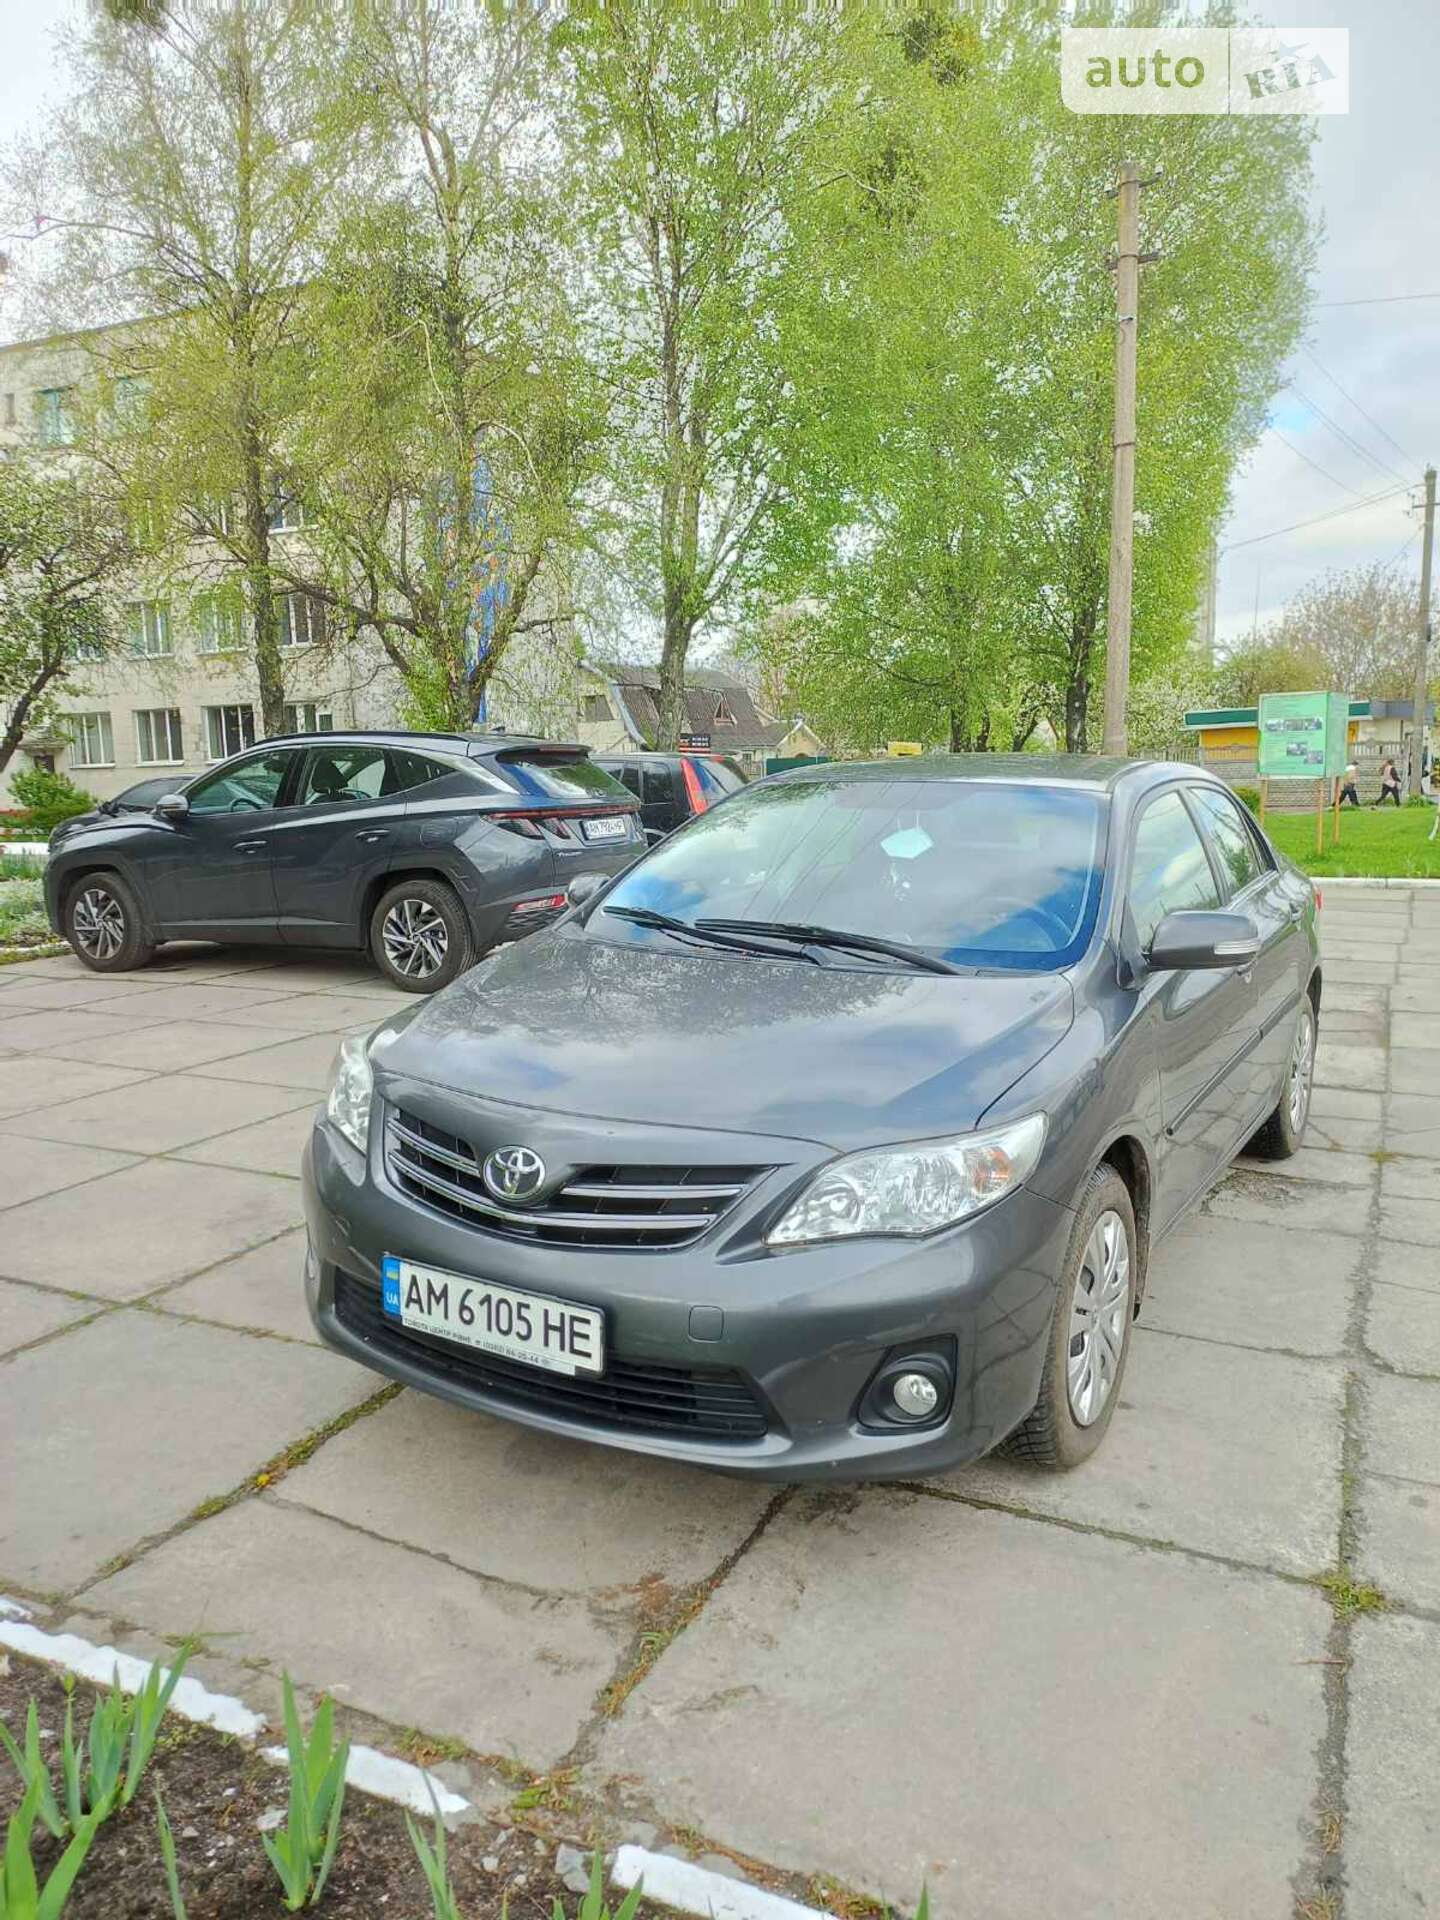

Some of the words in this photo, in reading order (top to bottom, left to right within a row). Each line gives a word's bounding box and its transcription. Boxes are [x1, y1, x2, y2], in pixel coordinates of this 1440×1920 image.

[385, 1292, 399, 1306] UA
[405, 1274, 449, 1321] AM
[458, 1289, 533, 1342] 6105
[543, 1308, 592, 1359] HE
